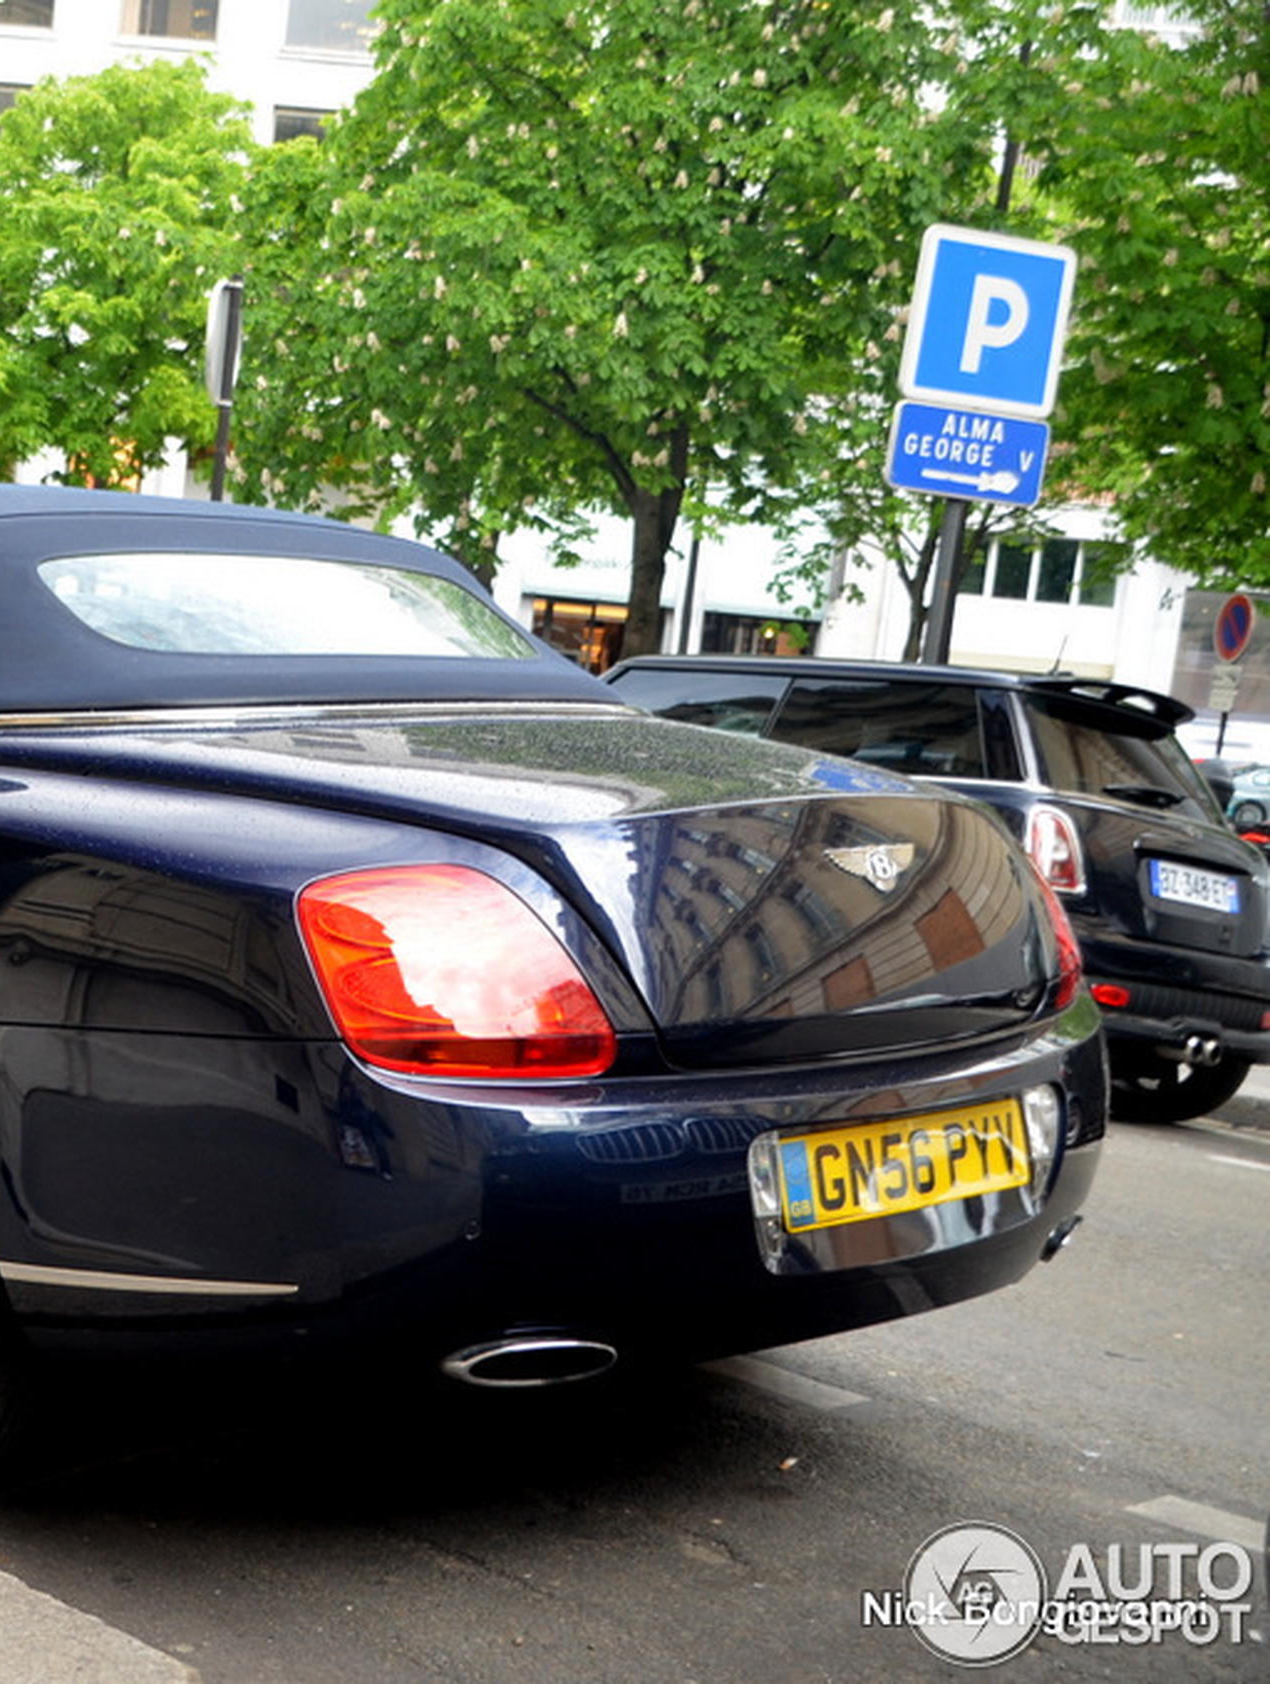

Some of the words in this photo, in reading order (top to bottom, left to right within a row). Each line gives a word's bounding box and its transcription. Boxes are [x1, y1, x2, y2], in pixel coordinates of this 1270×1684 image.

[959, 273, 1030, 375] P
[941, 413, 1005, 444] ALMA
[903, 432, 994, 468] GEORGE
[1019, 450, 1034, 473] V
[790, 1199, 812, 1218] GB
